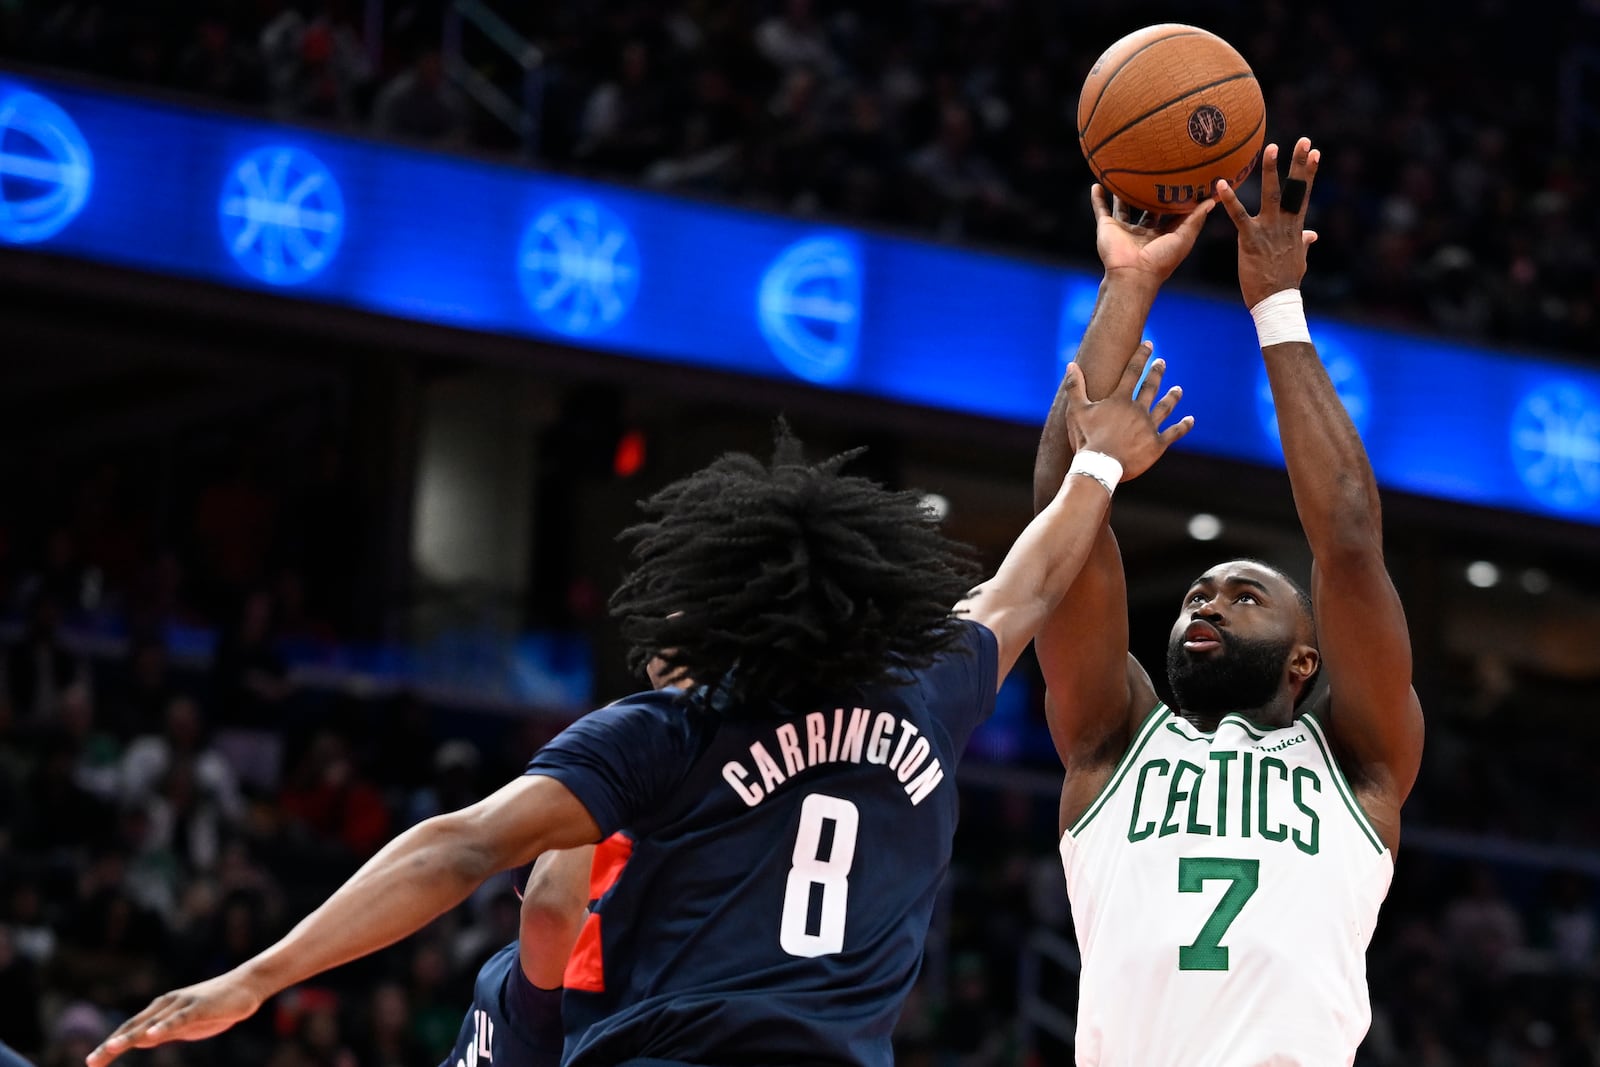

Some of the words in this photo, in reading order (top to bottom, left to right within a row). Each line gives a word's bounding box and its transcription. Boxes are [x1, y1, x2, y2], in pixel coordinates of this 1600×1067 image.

[722, 707, 945, 807] CARRINGTON
[1127, 750, 1322, 856] CELTICS
[780, 793, 859, 958] 8
[1178, 857, 1260, 971] 7
